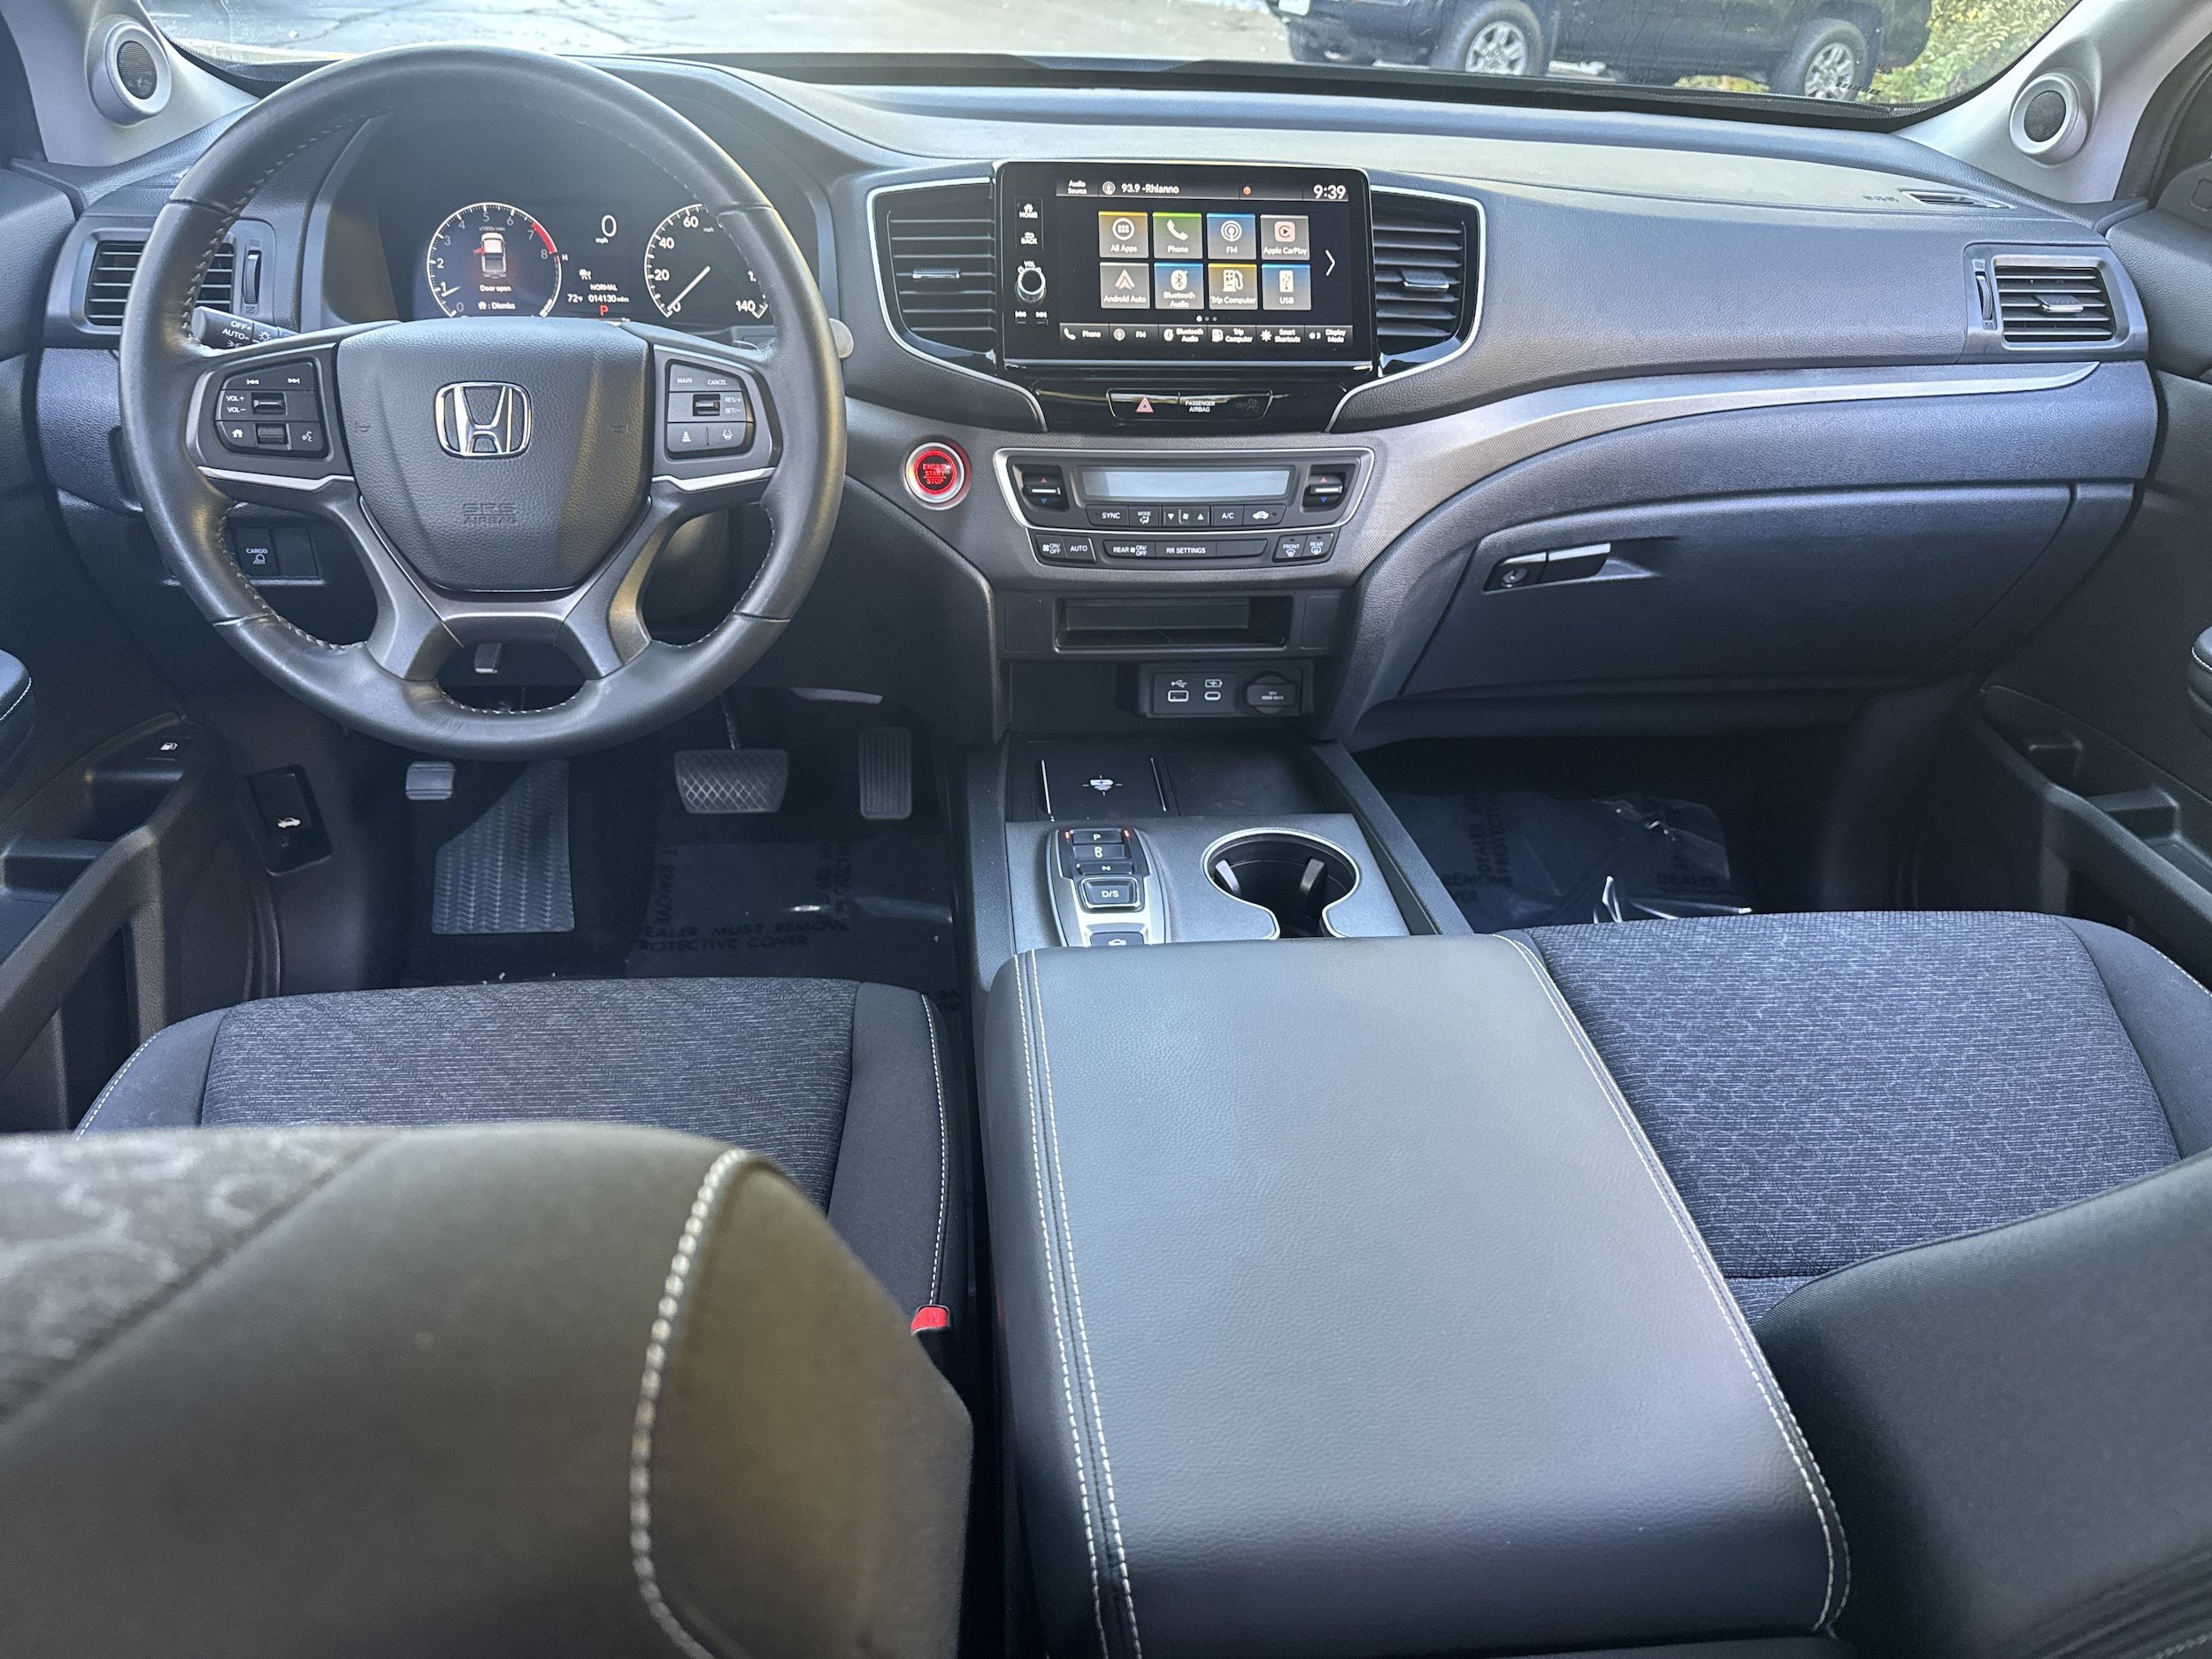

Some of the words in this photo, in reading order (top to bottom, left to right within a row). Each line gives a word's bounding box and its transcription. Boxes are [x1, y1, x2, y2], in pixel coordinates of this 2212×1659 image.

[1121, 183, 1141, 193] 93.9
[1313, 184, 1348, 200] 9:39
[482, 212, 489, 222] 5
[506, 216, 514, 226] 6
[683, 216, 699, 227] 60
[458, 220, 466, 230] 4
[601, 214, 617, 237] 0
[527, 230, 534, 240] 7
[444, 236, 451, 246] 3
[658, 237, 674, 250] 40
[541, 249, 549, 259] 8
[1121, 245, 1138, 254] Apps
[1283, 247, 1308, 256] CarPlay
[436, 257, 444, 269] 2
[654, 269, 670, 280] 20
[441, 281, 447, 293] 1
[735, 300, 757, 311] 140
[1224, 296, 1256, 305] Computer
[457, 303, 464, 312] 0
[600, 304, 609, 316] P
[231, 320, 248, 329] OFF
[222, 328, 245, 340] AUTO
[1325, 328, 1347, 337] Display
[1101, 889, 1119, 899] D/S
